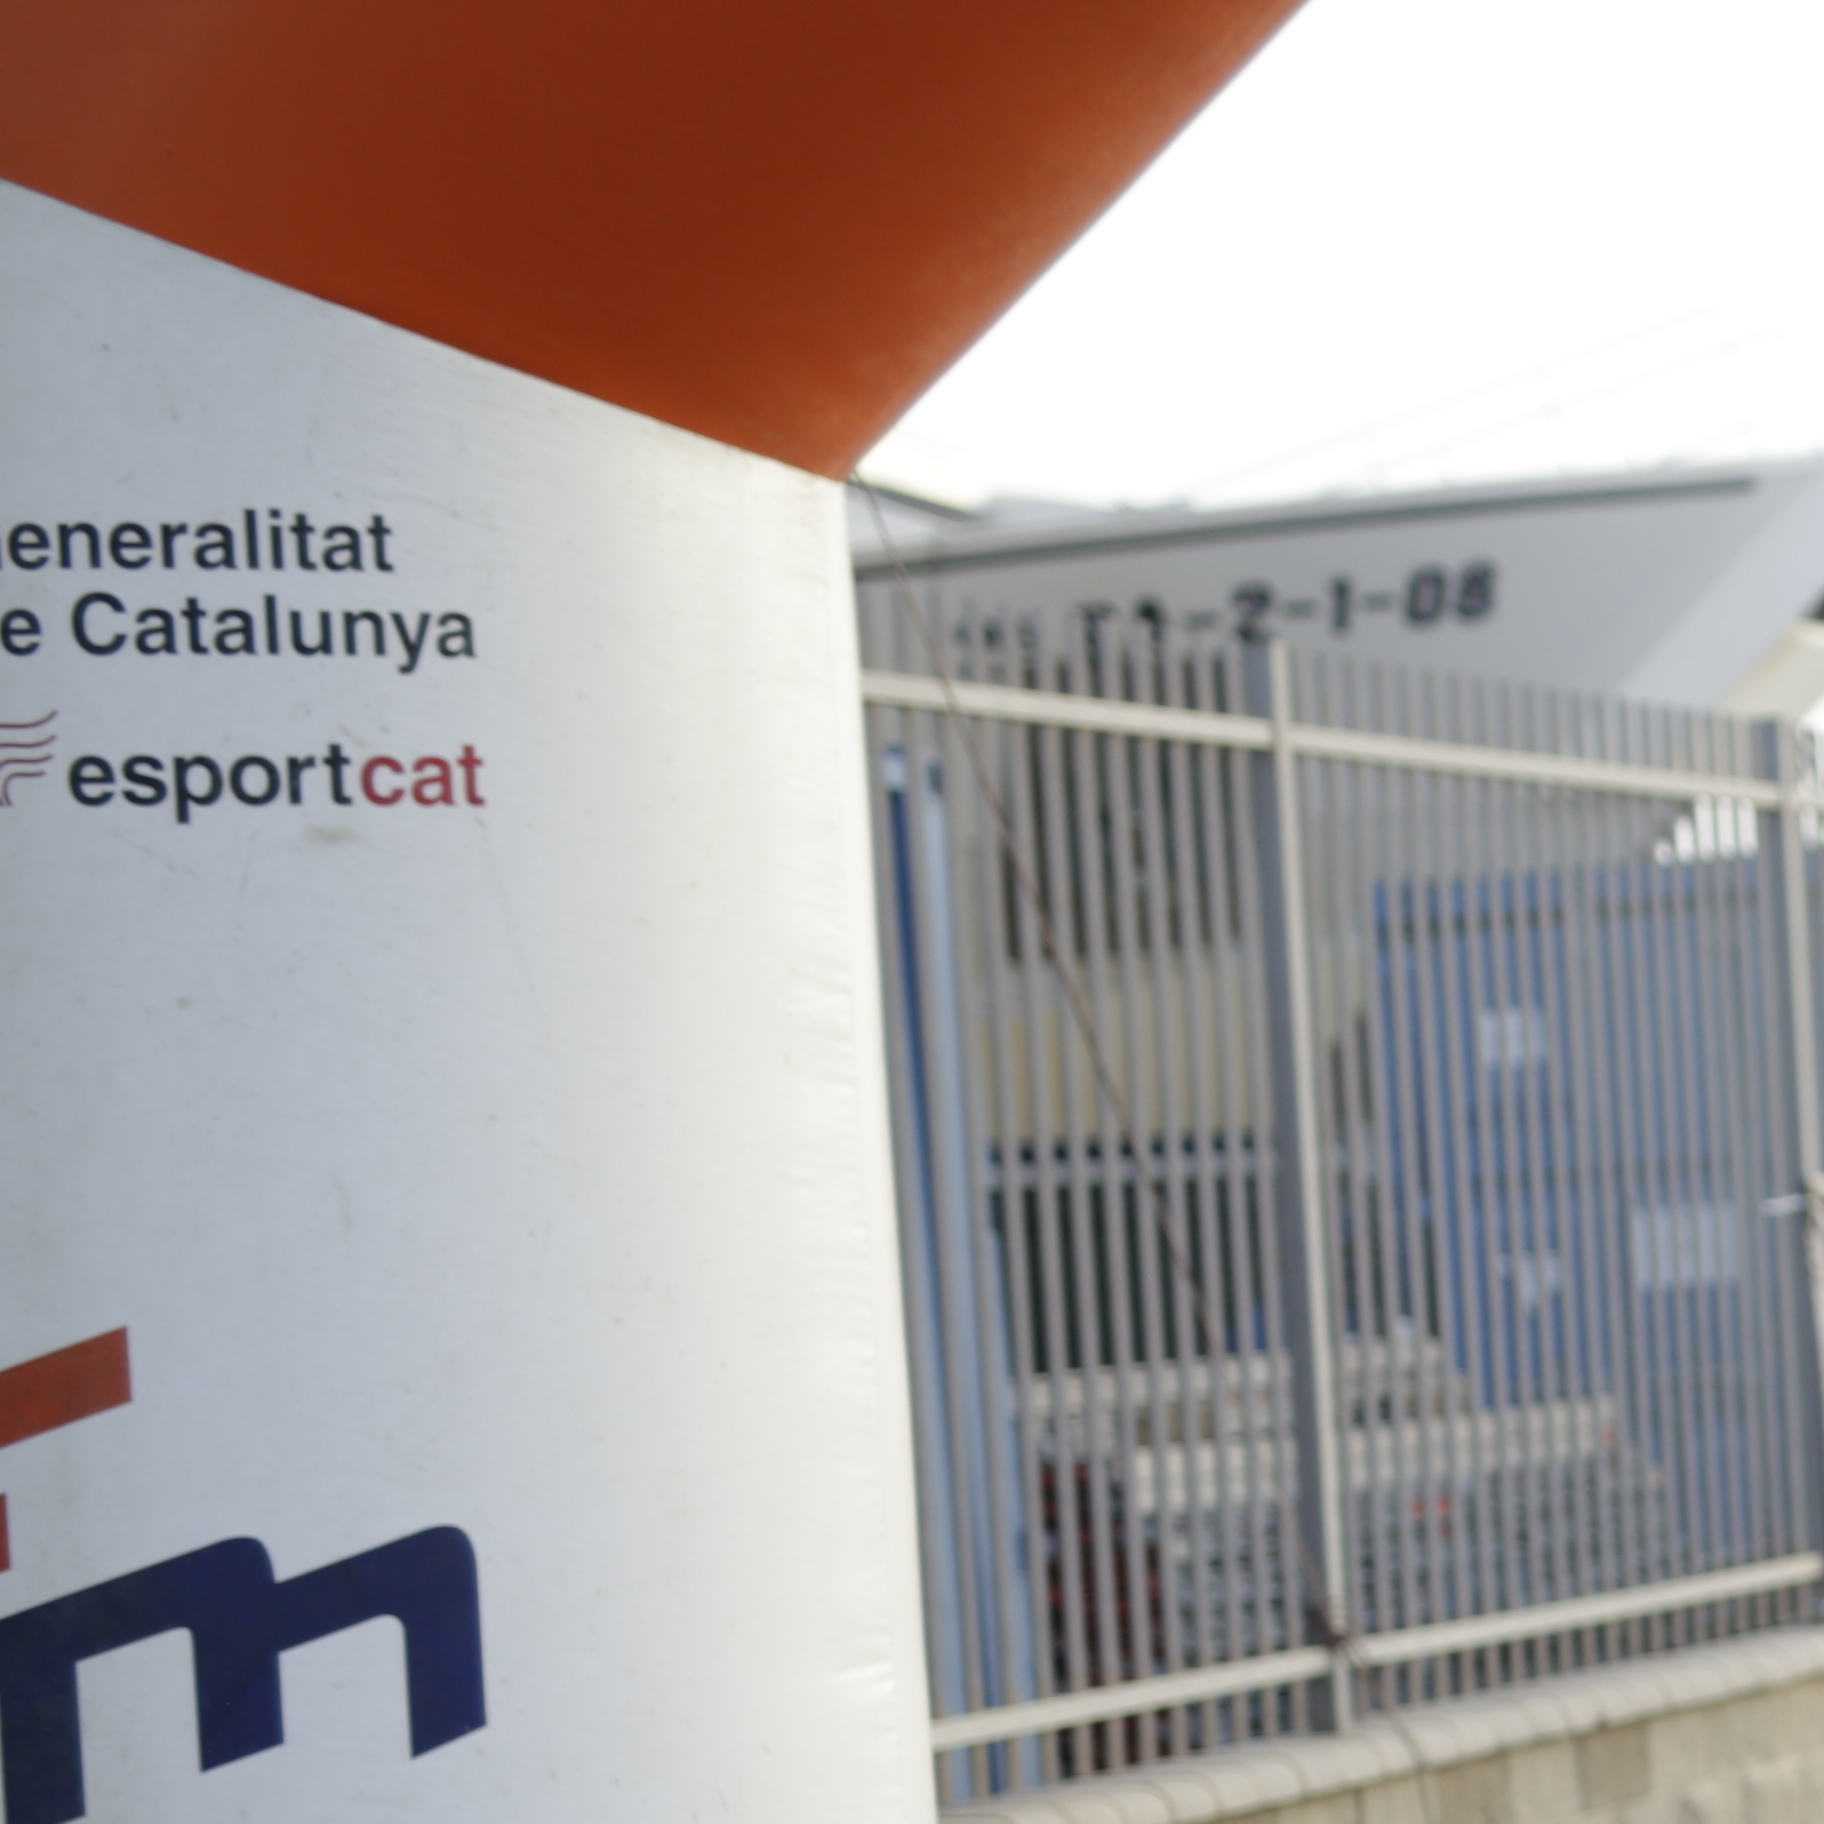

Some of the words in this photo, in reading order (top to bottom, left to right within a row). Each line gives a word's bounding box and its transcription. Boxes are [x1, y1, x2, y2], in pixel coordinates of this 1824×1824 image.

[0, 508, 394, 572] eneralitat
[71, 591, 477, 674] Catalunya
[68, 743, 486, 824] esportcat
